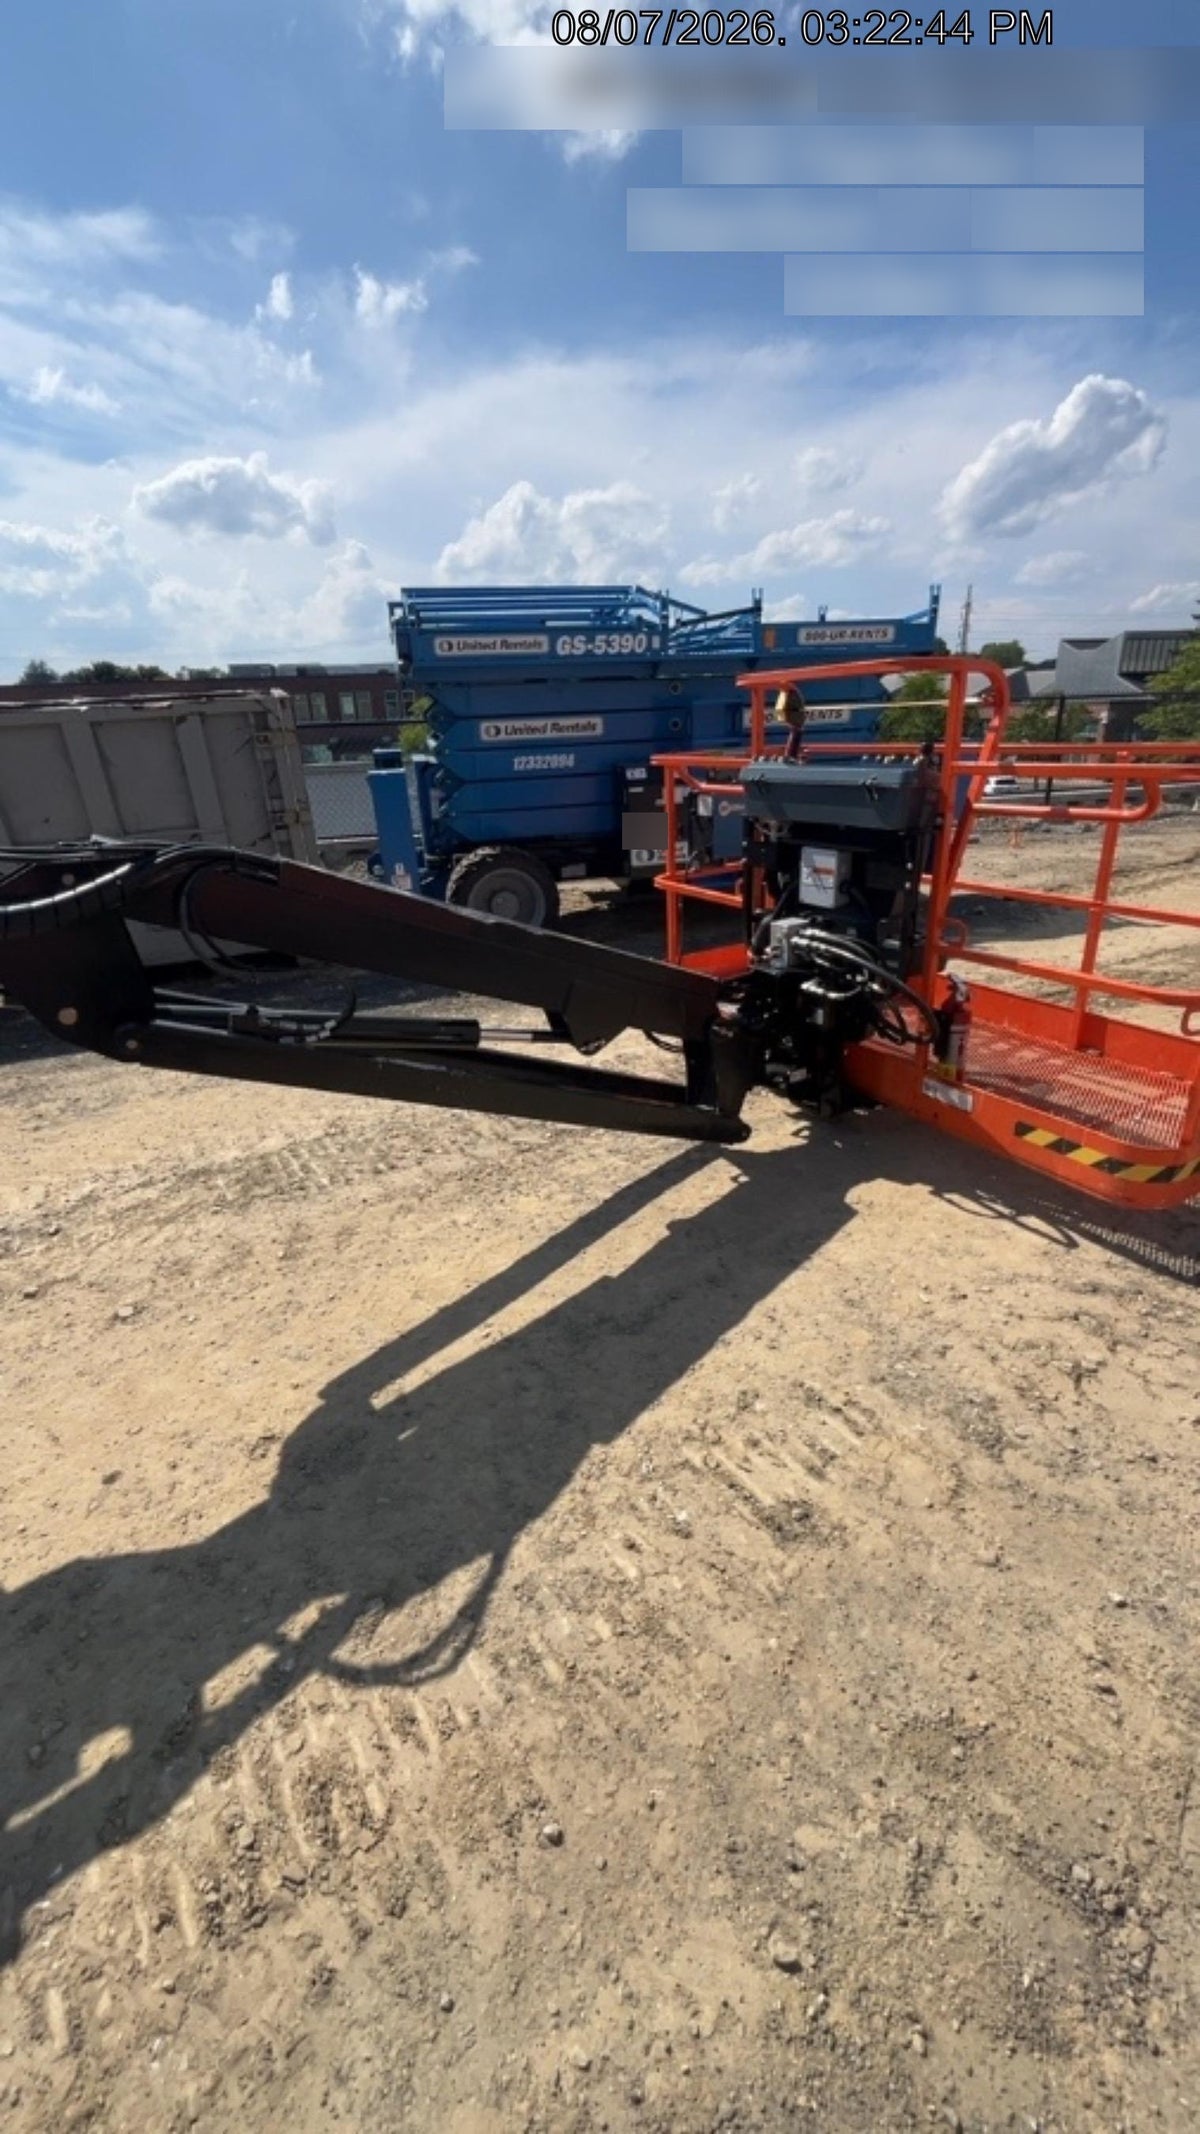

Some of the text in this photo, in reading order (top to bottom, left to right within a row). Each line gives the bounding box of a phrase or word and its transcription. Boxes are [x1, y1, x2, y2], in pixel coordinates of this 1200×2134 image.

[457, 638, 544, 651] United Rentals
[556, 633, 647, 656] GS-5390
[504, 720, 597, 736] United Rentals
